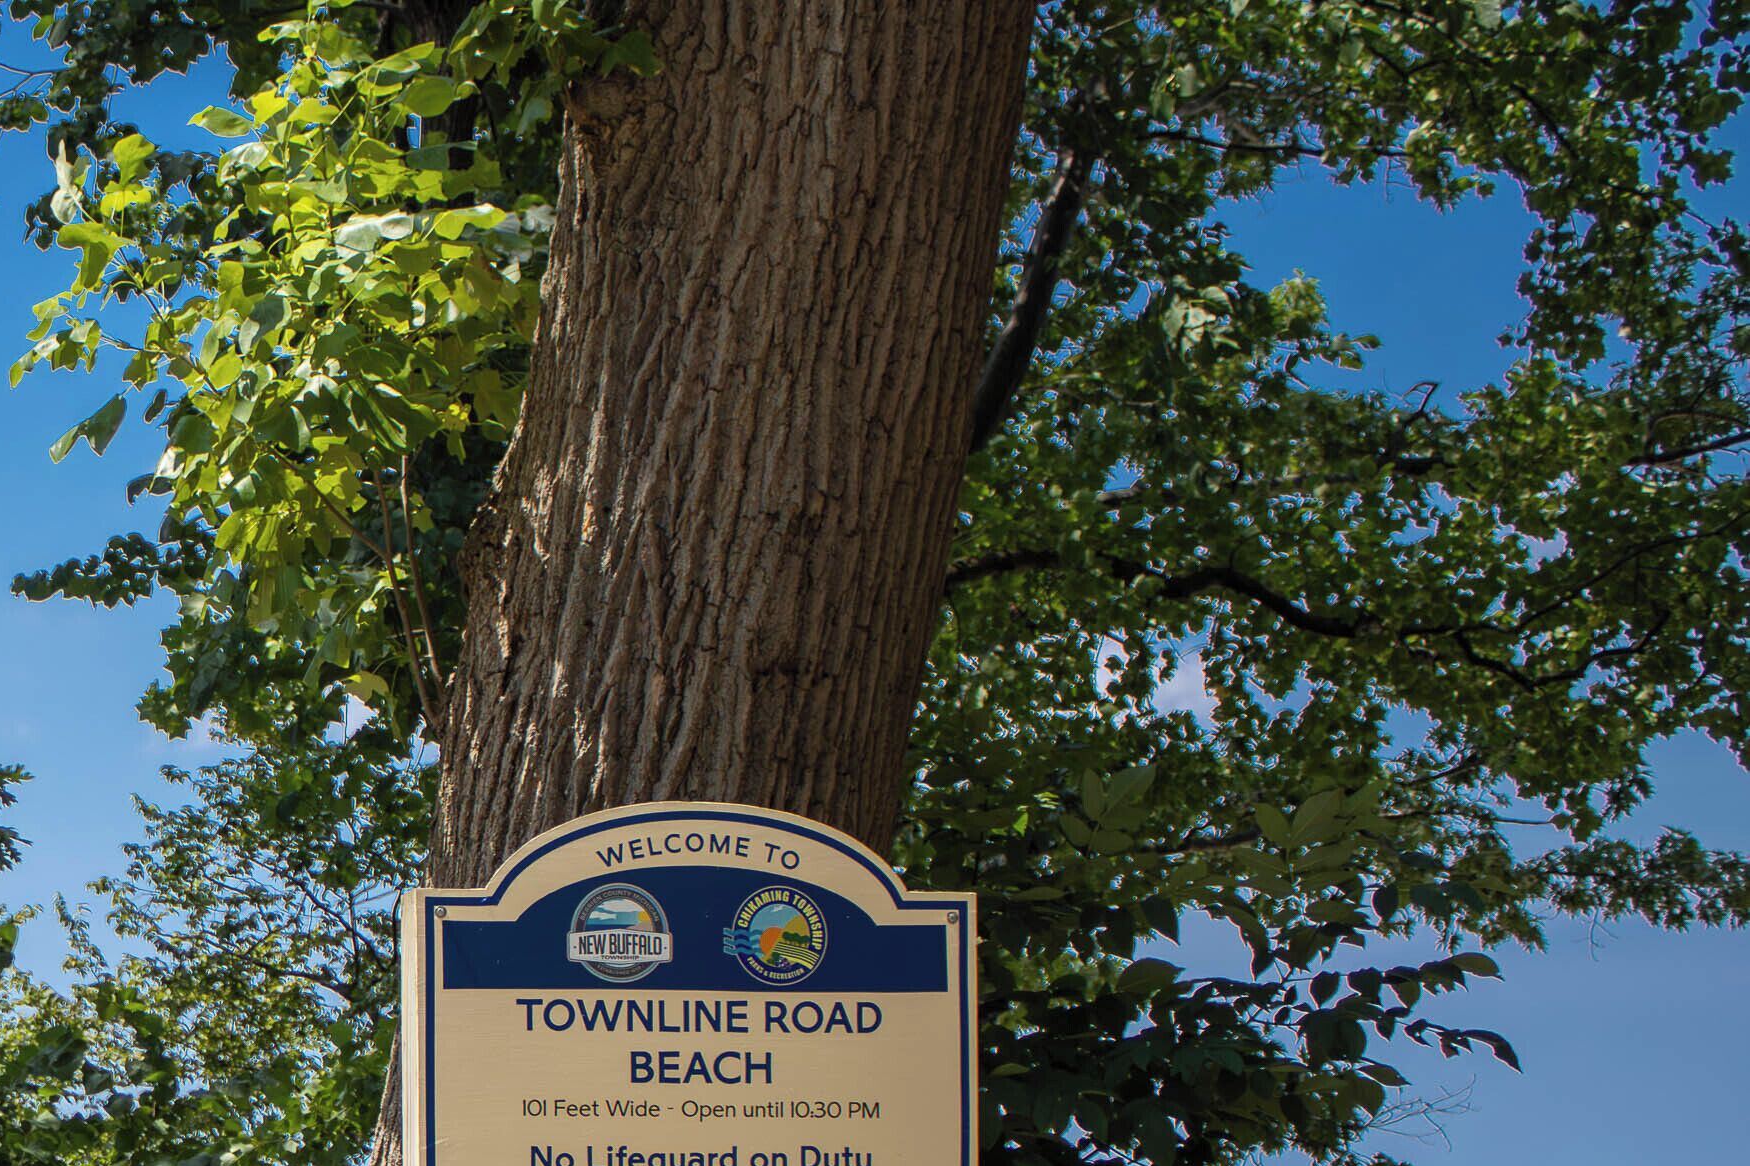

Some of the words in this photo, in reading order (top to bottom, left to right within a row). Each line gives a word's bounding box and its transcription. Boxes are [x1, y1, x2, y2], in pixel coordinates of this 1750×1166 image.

[596, 833, 751, 867] WELCOME
[765, 842, 800, 870] TO
[737, 890, 790, 929] CHIKAMING
[792, 894, 823, 951] TOWNSHIP
[578, 934, 607, 955] NEW
[609, 933, 663, 955] BUFFALO
[515, 998, 749, 1033] TOWNLINE
[764, 1000, 882, 1033] ROAD
[630, 1050, 772, 1084] BEACH
[522, 1099, 546, 1116] 101
[553, 1099, 599, 1117] Feet
[605, 1099, 660, 1117] Wide
[681, 1099, 736, 1122] Open
[743, 1100, 783, 1118] until
[790, 1100, 841, 1118] 10:30
[848, 1101, 880, 1118] PM
